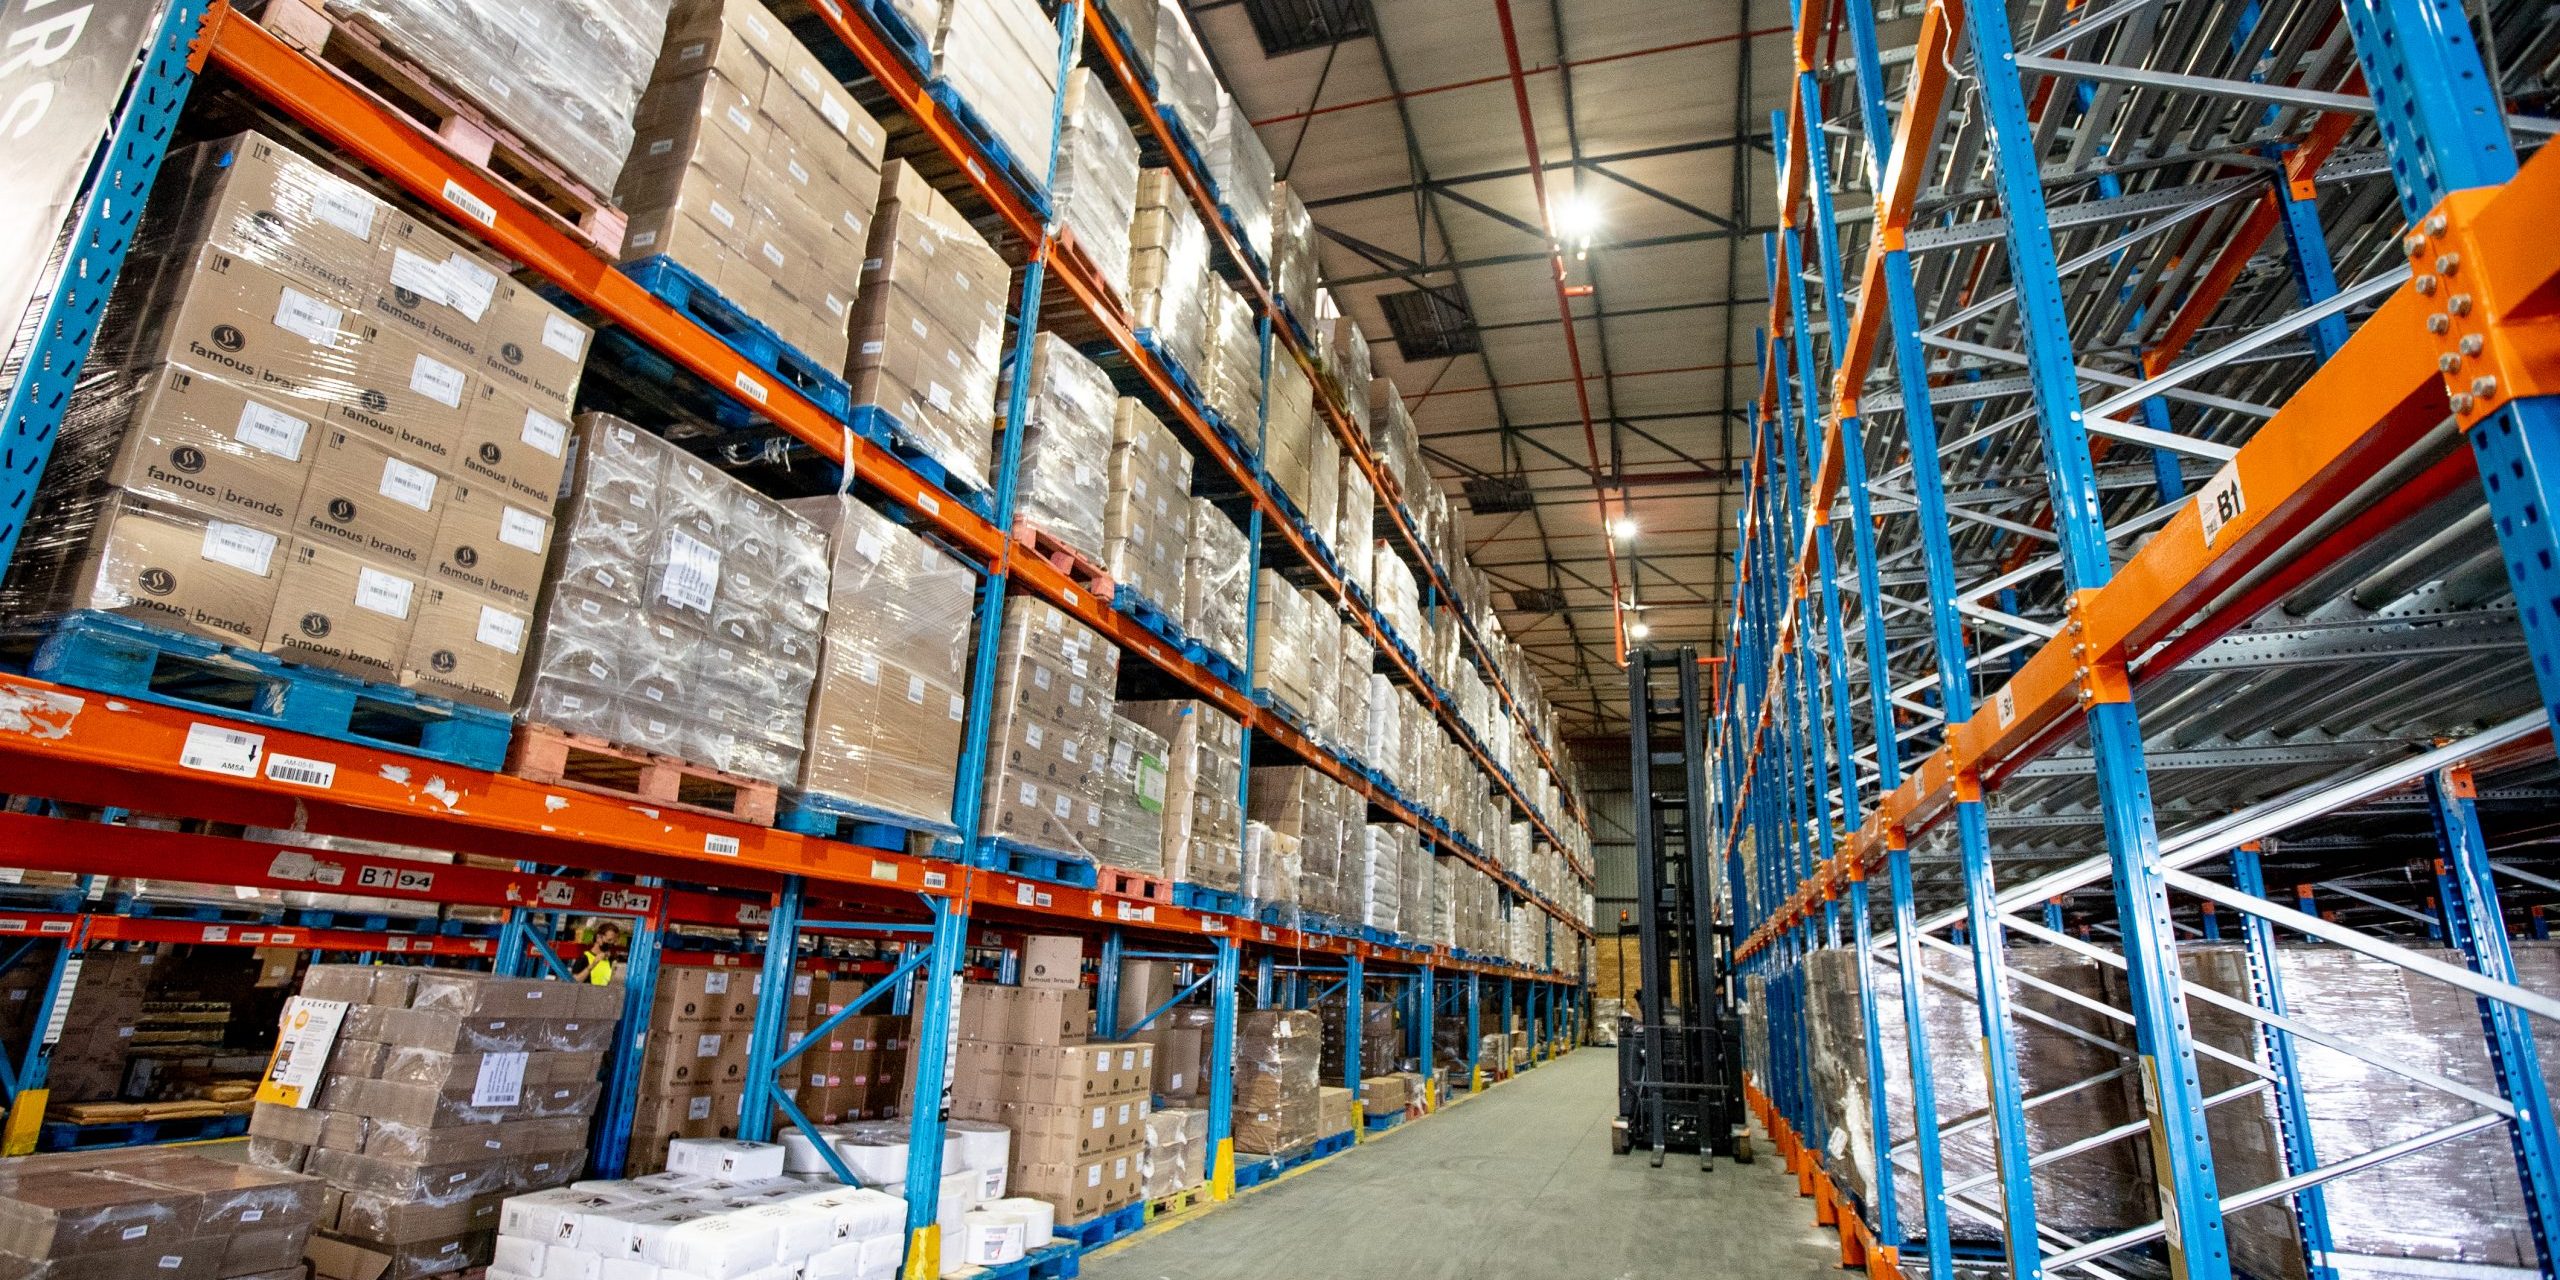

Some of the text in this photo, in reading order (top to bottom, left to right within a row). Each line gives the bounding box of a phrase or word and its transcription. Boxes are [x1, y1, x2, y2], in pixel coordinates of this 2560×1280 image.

[0, 0, 94, 138] RS
[377, 297, 427, 331] famous
[432, 325, 476, 355] brands
[190, 341, 254, 376] famous
[487, 355, 528, 384] famous
[342, 406, 447, 456] famous brands
[148, 466, 284, 517] famous brands
[464, 457, 548, 502] famous brands
[309, 516, 417, 561] famous brands
[439, 562, 529, 601] famous brands
[196, 609, 252, 635] brands
[281, 634, 394, 671] famous brands
[221, 762, 245, 772] AM5A
[361, 868, 431, 888] B 94
